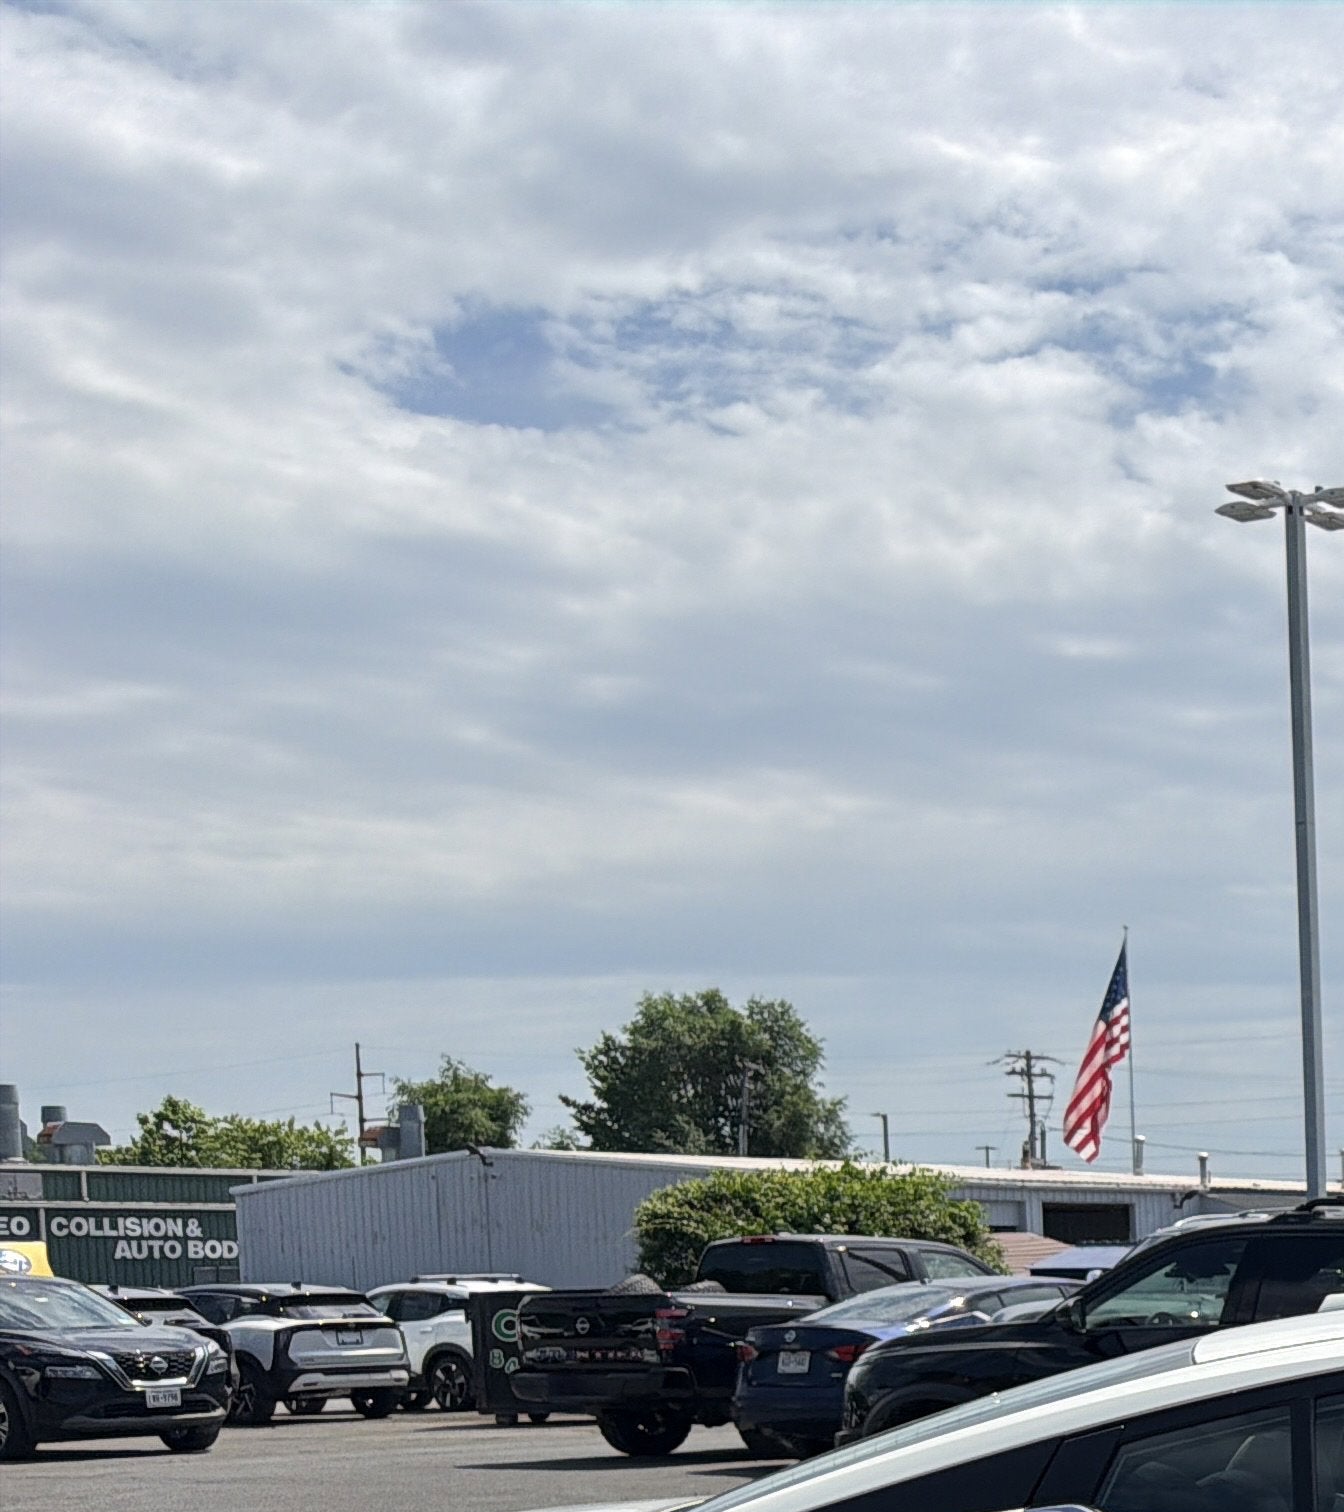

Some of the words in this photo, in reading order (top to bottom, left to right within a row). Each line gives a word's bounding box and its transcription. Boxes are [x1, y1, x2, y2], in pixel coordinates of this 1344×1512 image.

[50, 1216, 183, 1237] COLLISION
[186, 1217, 203, 1237] &
[114, 1240, 182, 1260] AUTO
[188, 1240, 239, 1259] BOD
